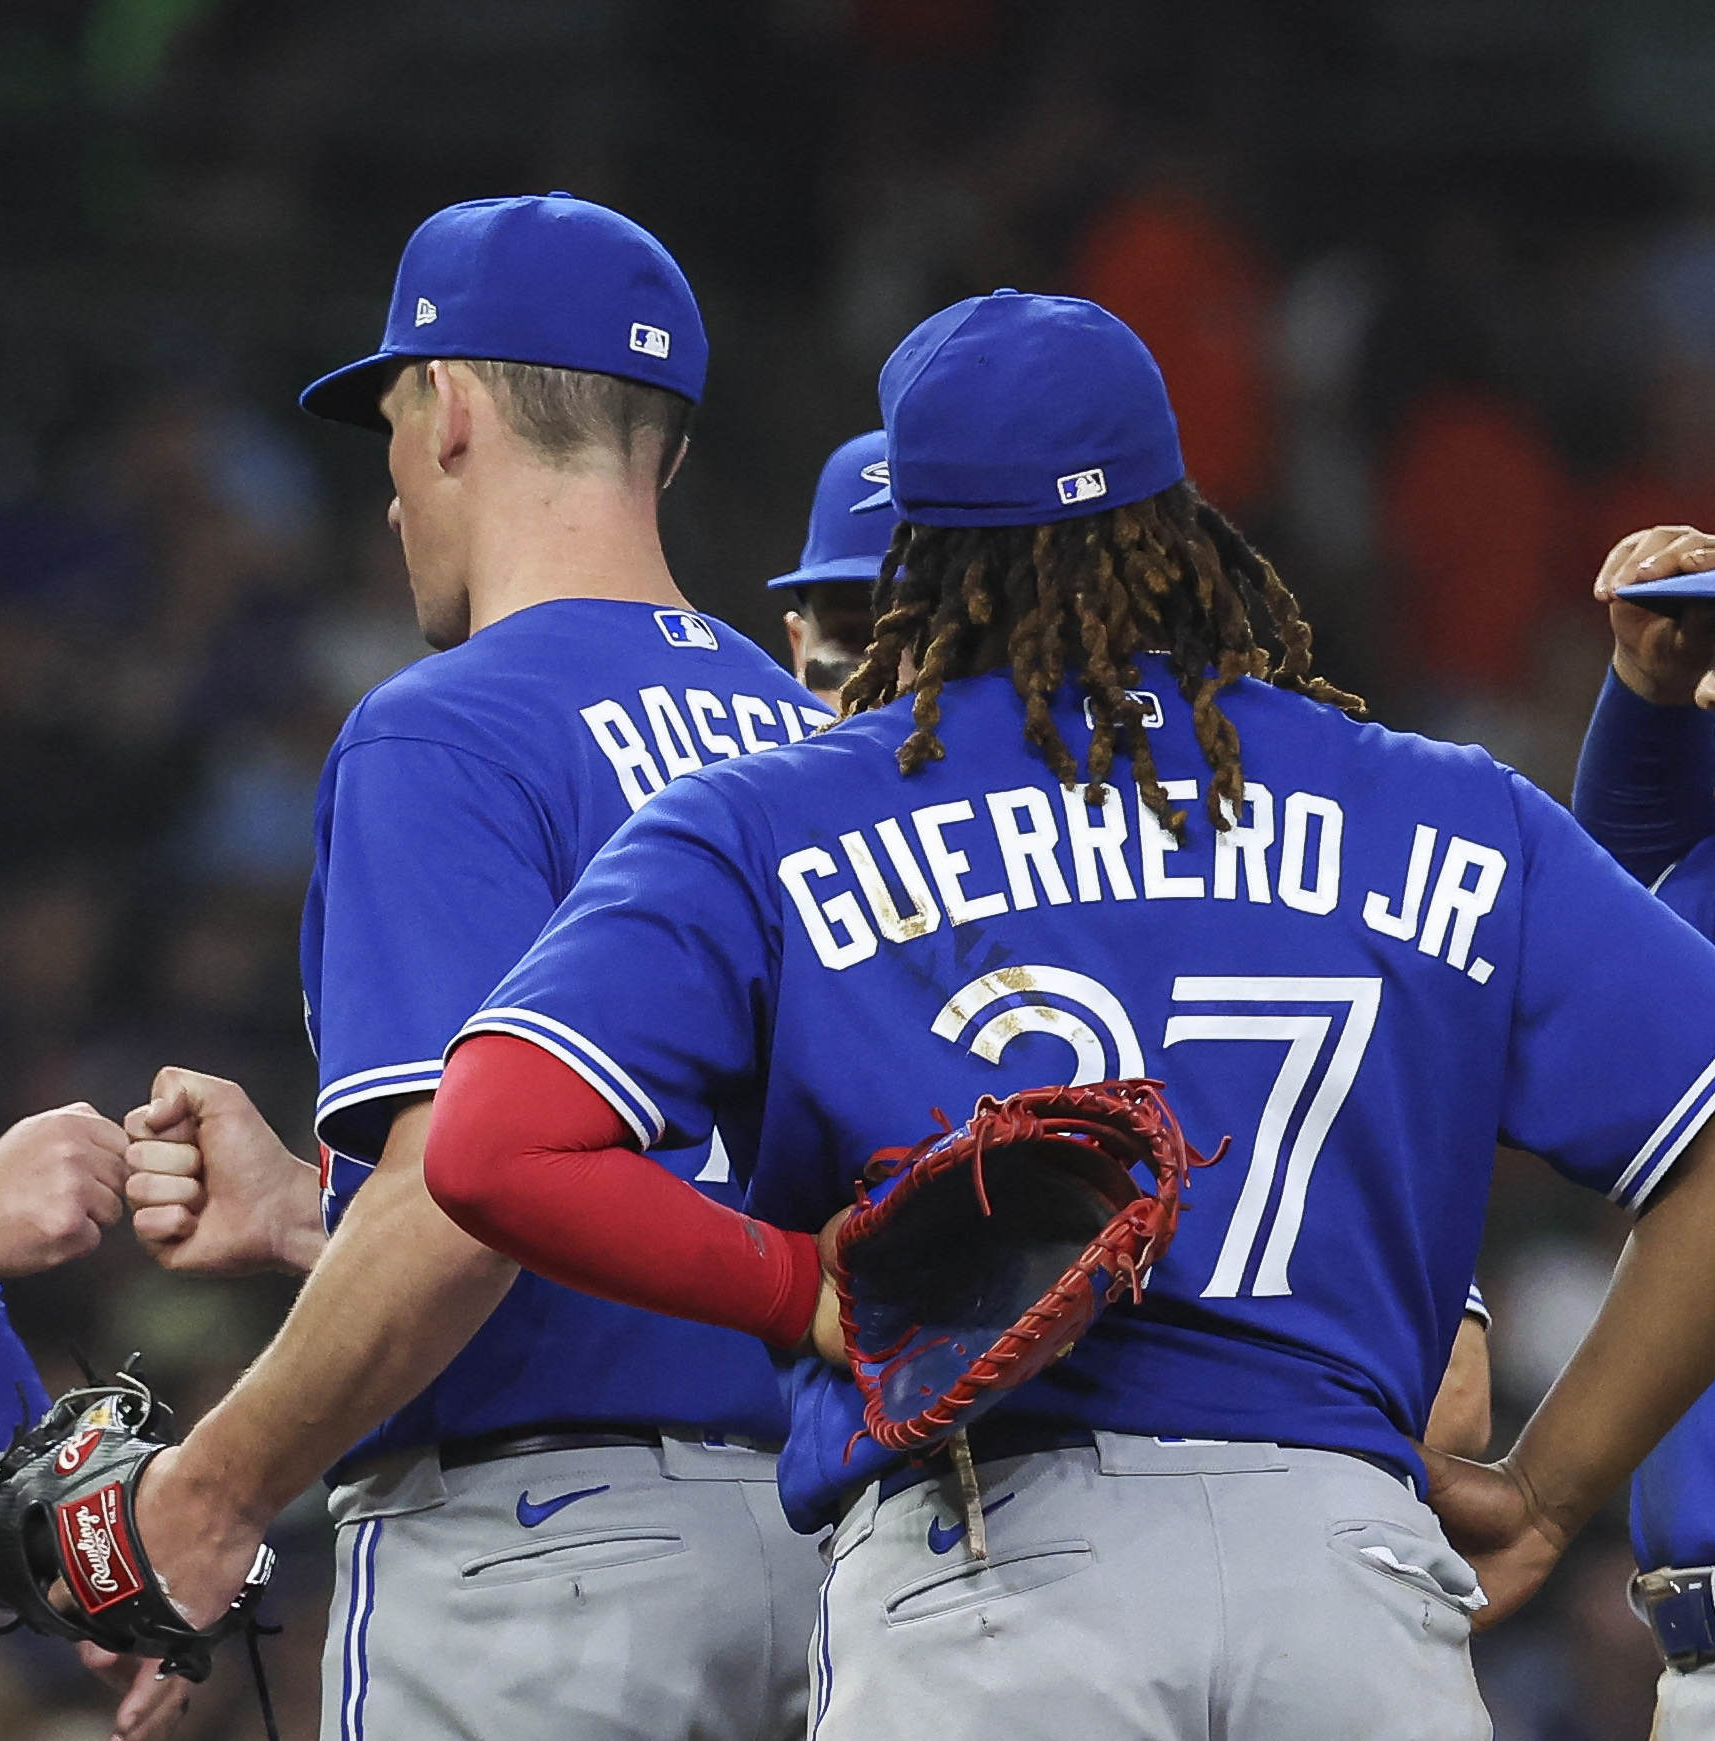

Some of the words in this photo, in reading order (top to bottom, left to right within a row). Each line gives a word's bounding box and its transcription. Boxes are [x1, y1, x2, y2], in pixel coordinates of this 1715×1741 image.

[777, 777, 1345, 972] GUERRERO
[1361, 823, 1507, 984] JR.
[75, 1505, 119, 1593] Rawlings
